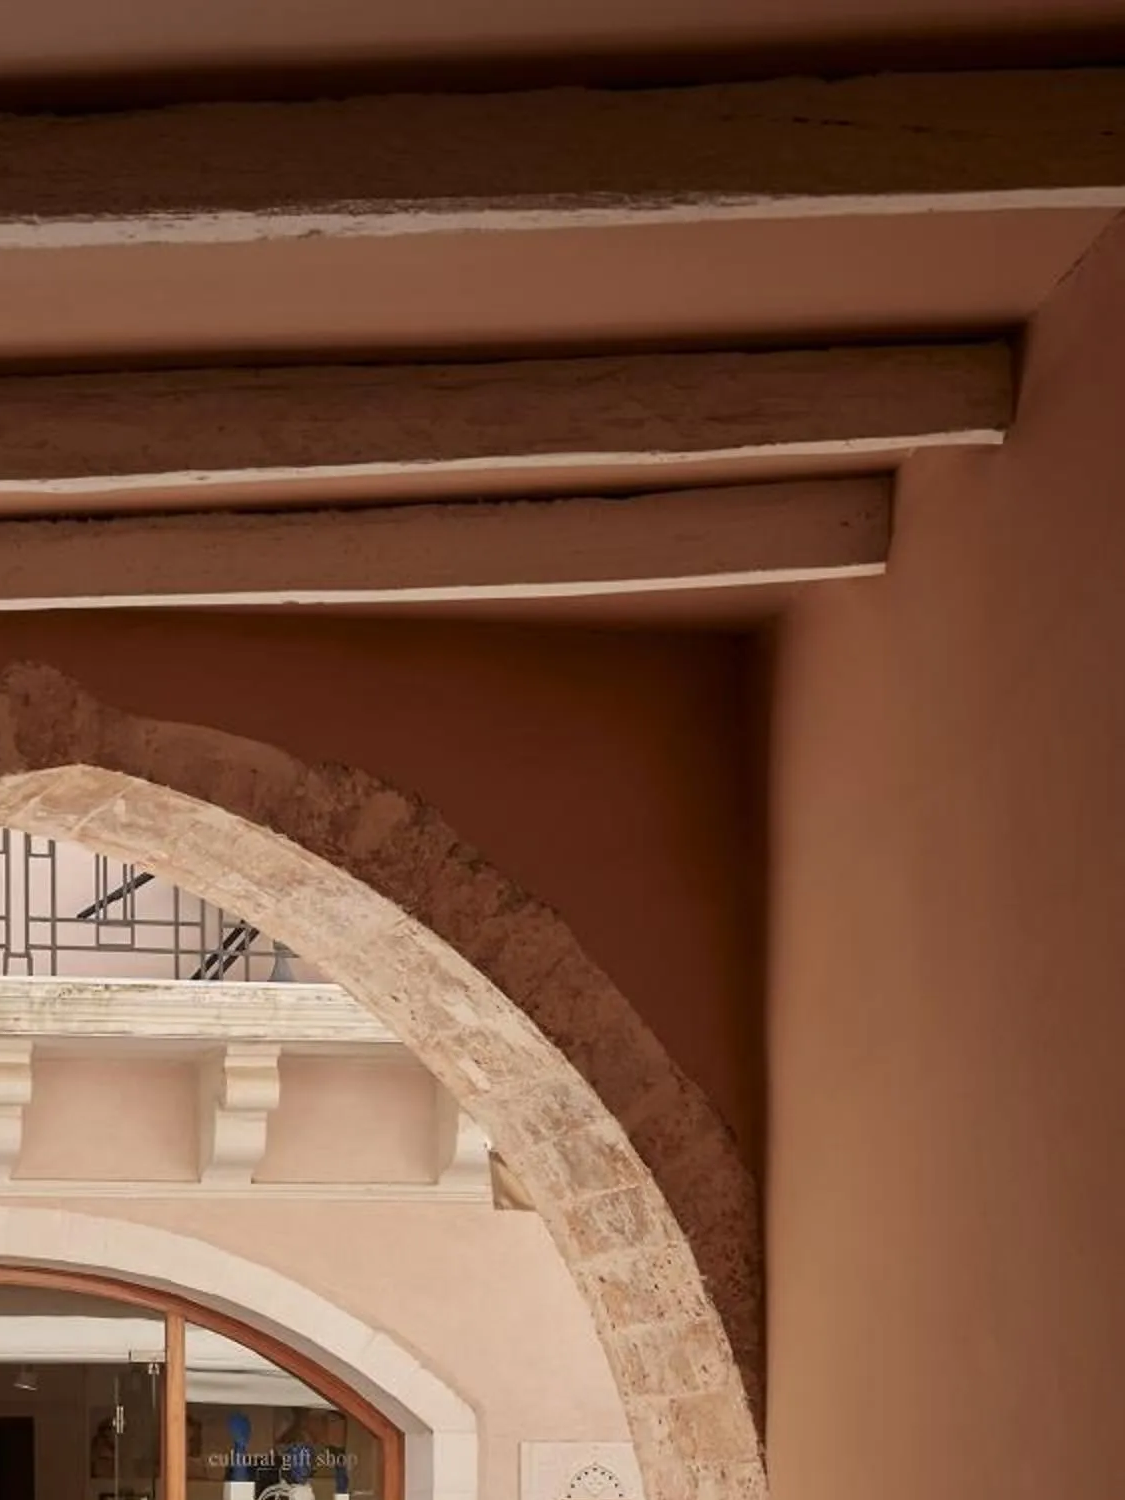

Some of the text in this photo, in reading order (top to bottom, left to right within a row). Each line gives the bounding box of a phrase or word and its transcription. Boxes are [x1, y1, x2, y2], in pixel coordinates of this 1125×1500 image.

[208, 1446, 359, 1471] cultural gift shop
